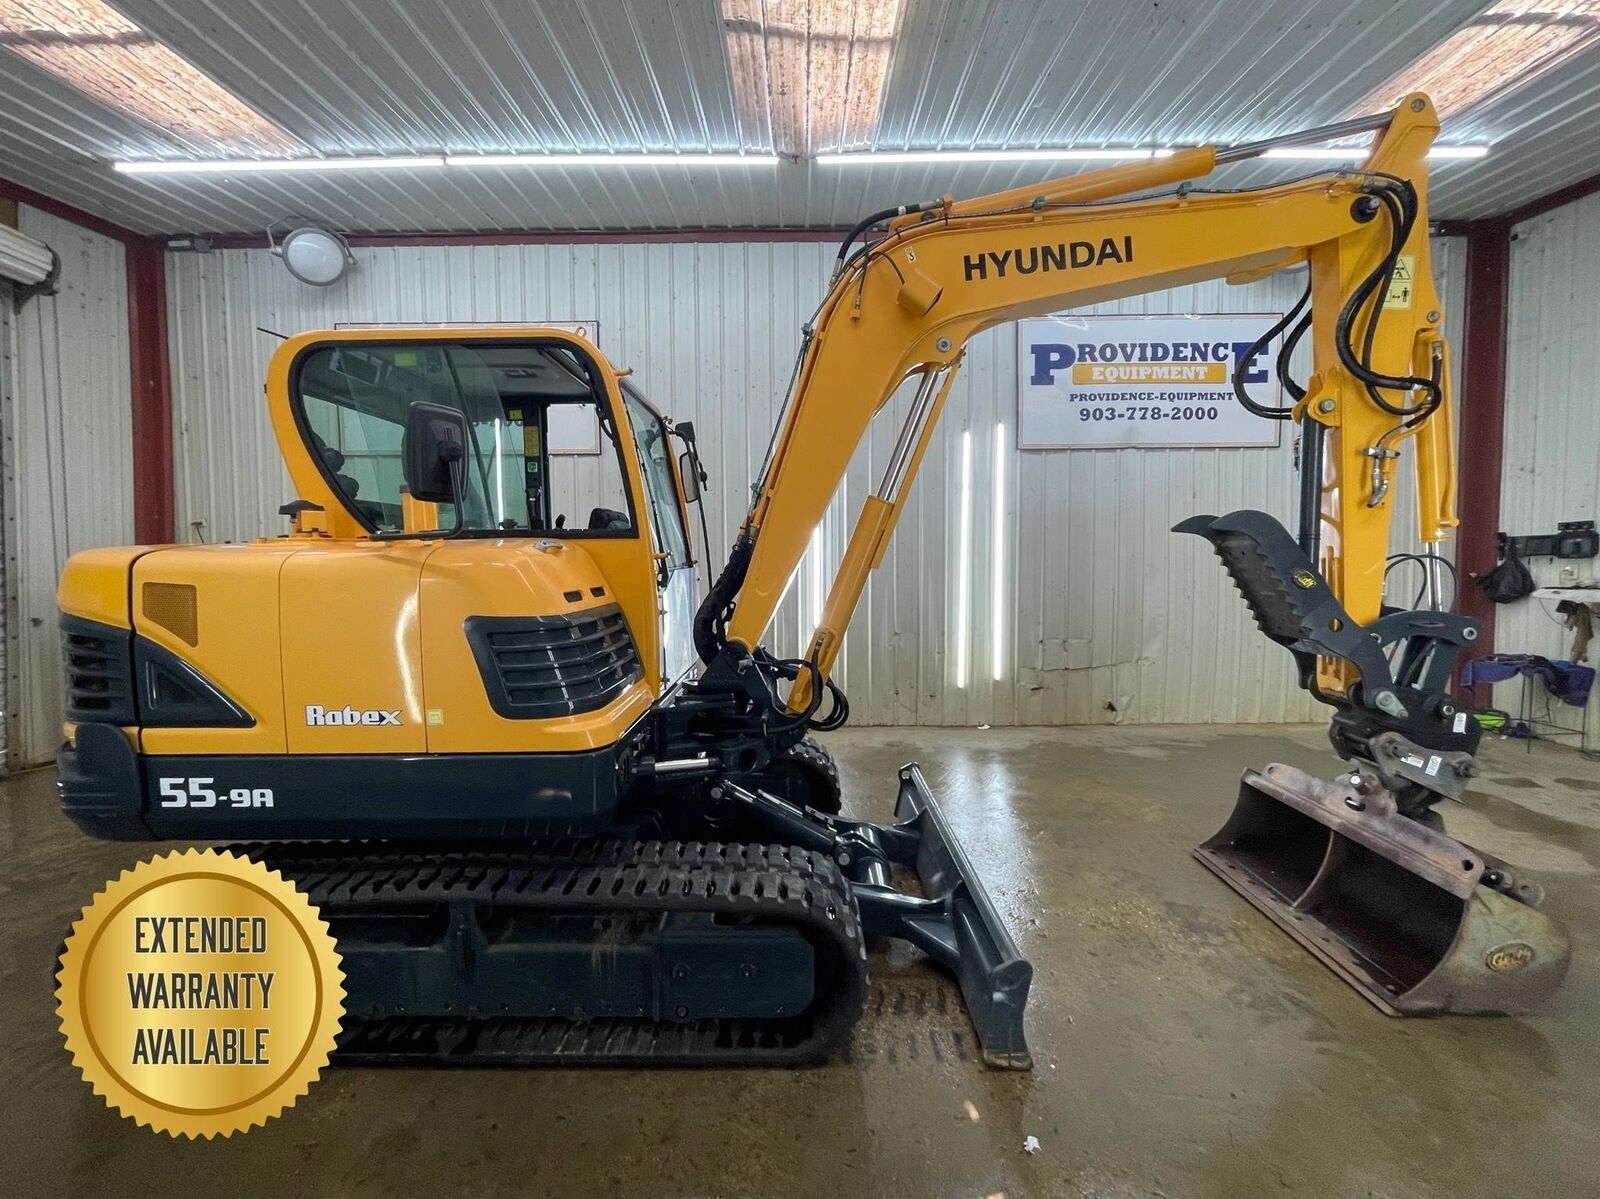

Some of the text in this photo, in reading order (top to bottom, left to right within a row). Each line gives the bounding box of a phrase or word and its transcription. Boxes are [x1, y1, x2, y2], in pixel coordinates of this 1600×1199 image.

[963, 235, 1134, 281] HYUNDAI
[1030, 342, 1269, 386] PROVIDENCE
[1092, 366, 1208, 381] EQUIPMENT
[1079, 407, 1218, 421] 903-778-2000
[305, 705, 403, 726] Robex
[159, 777, 274, 808] 55-9A
